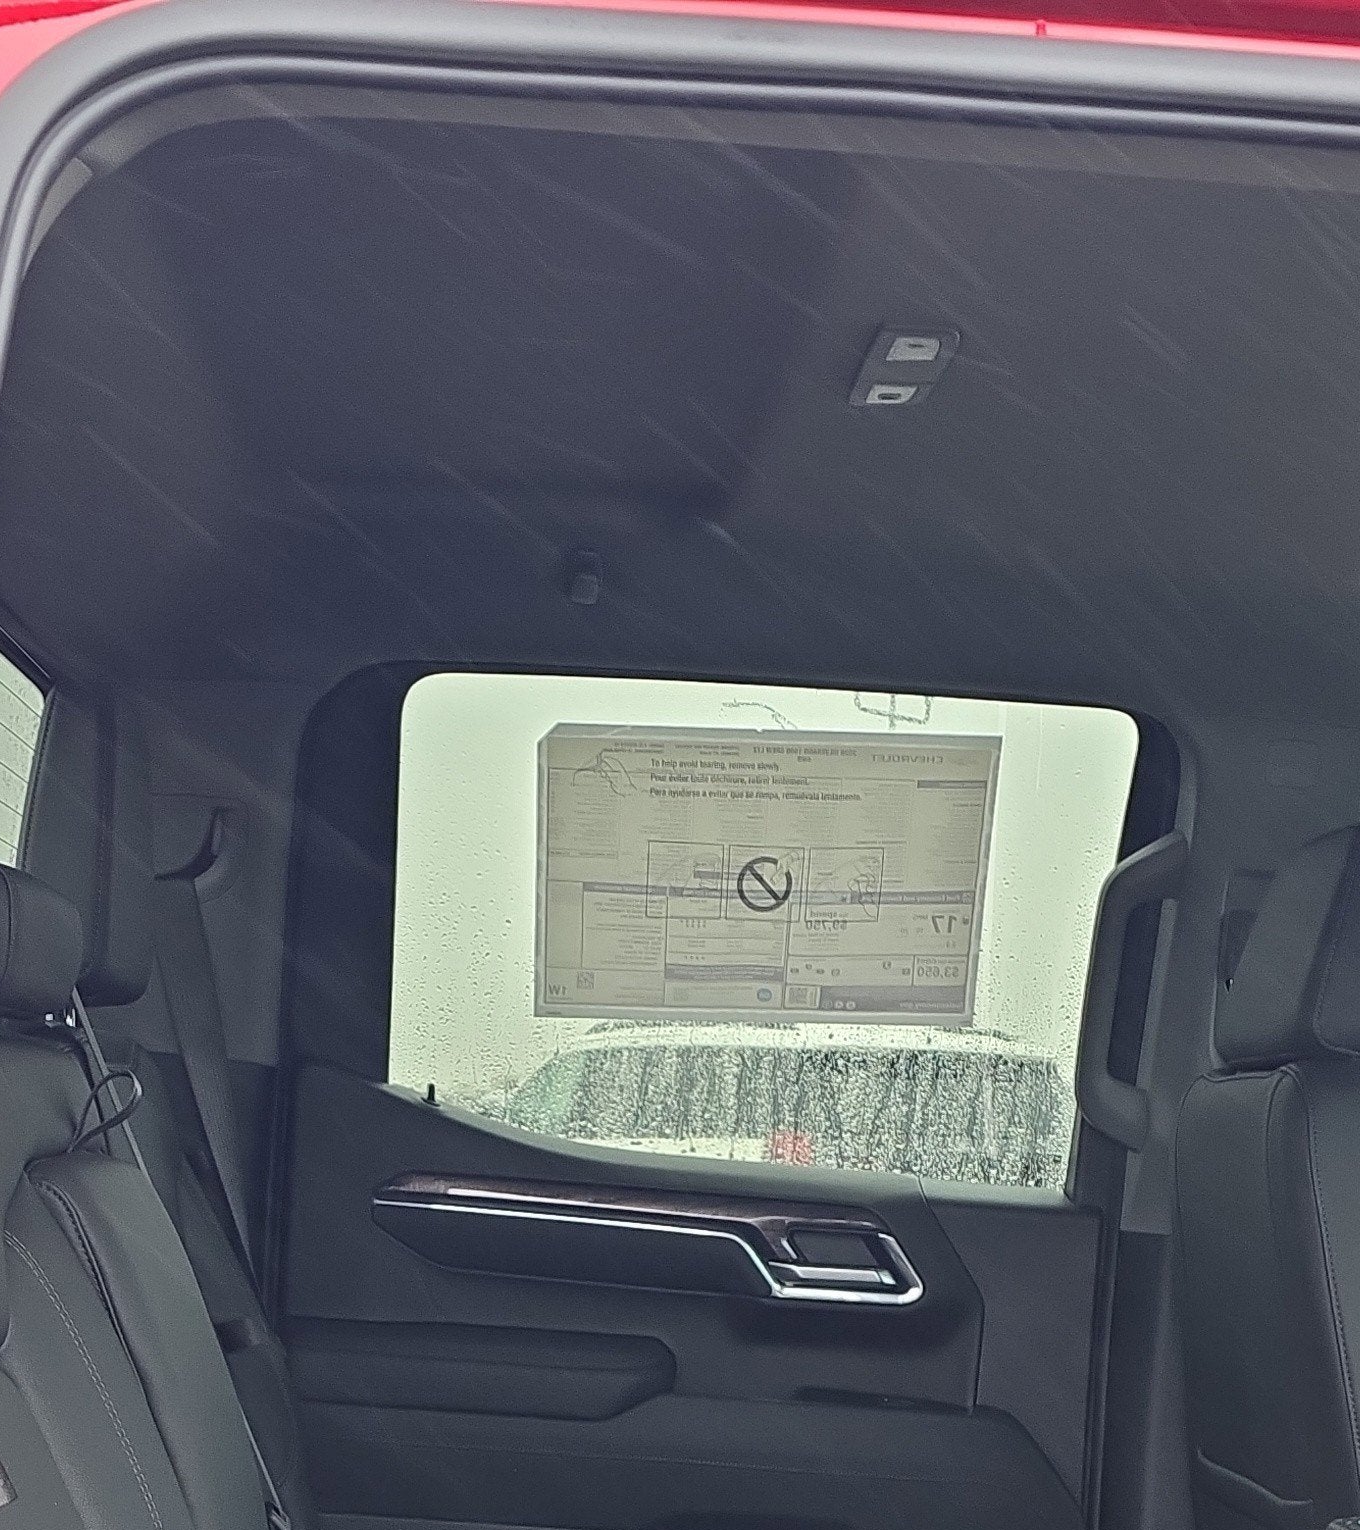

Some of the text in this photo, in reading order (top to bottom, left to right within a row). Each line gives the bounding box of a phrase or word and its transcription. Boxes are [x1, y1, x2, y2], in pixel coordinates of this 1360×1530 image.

[650, 758, 660, 767] To
[661, 759, 678, 769] help
[679, 759, 698, 768] avoid
[728, 762, 756, 770] remove
[650, 773, 667, 782] Pour
[649, 787, 666, 796] Para
